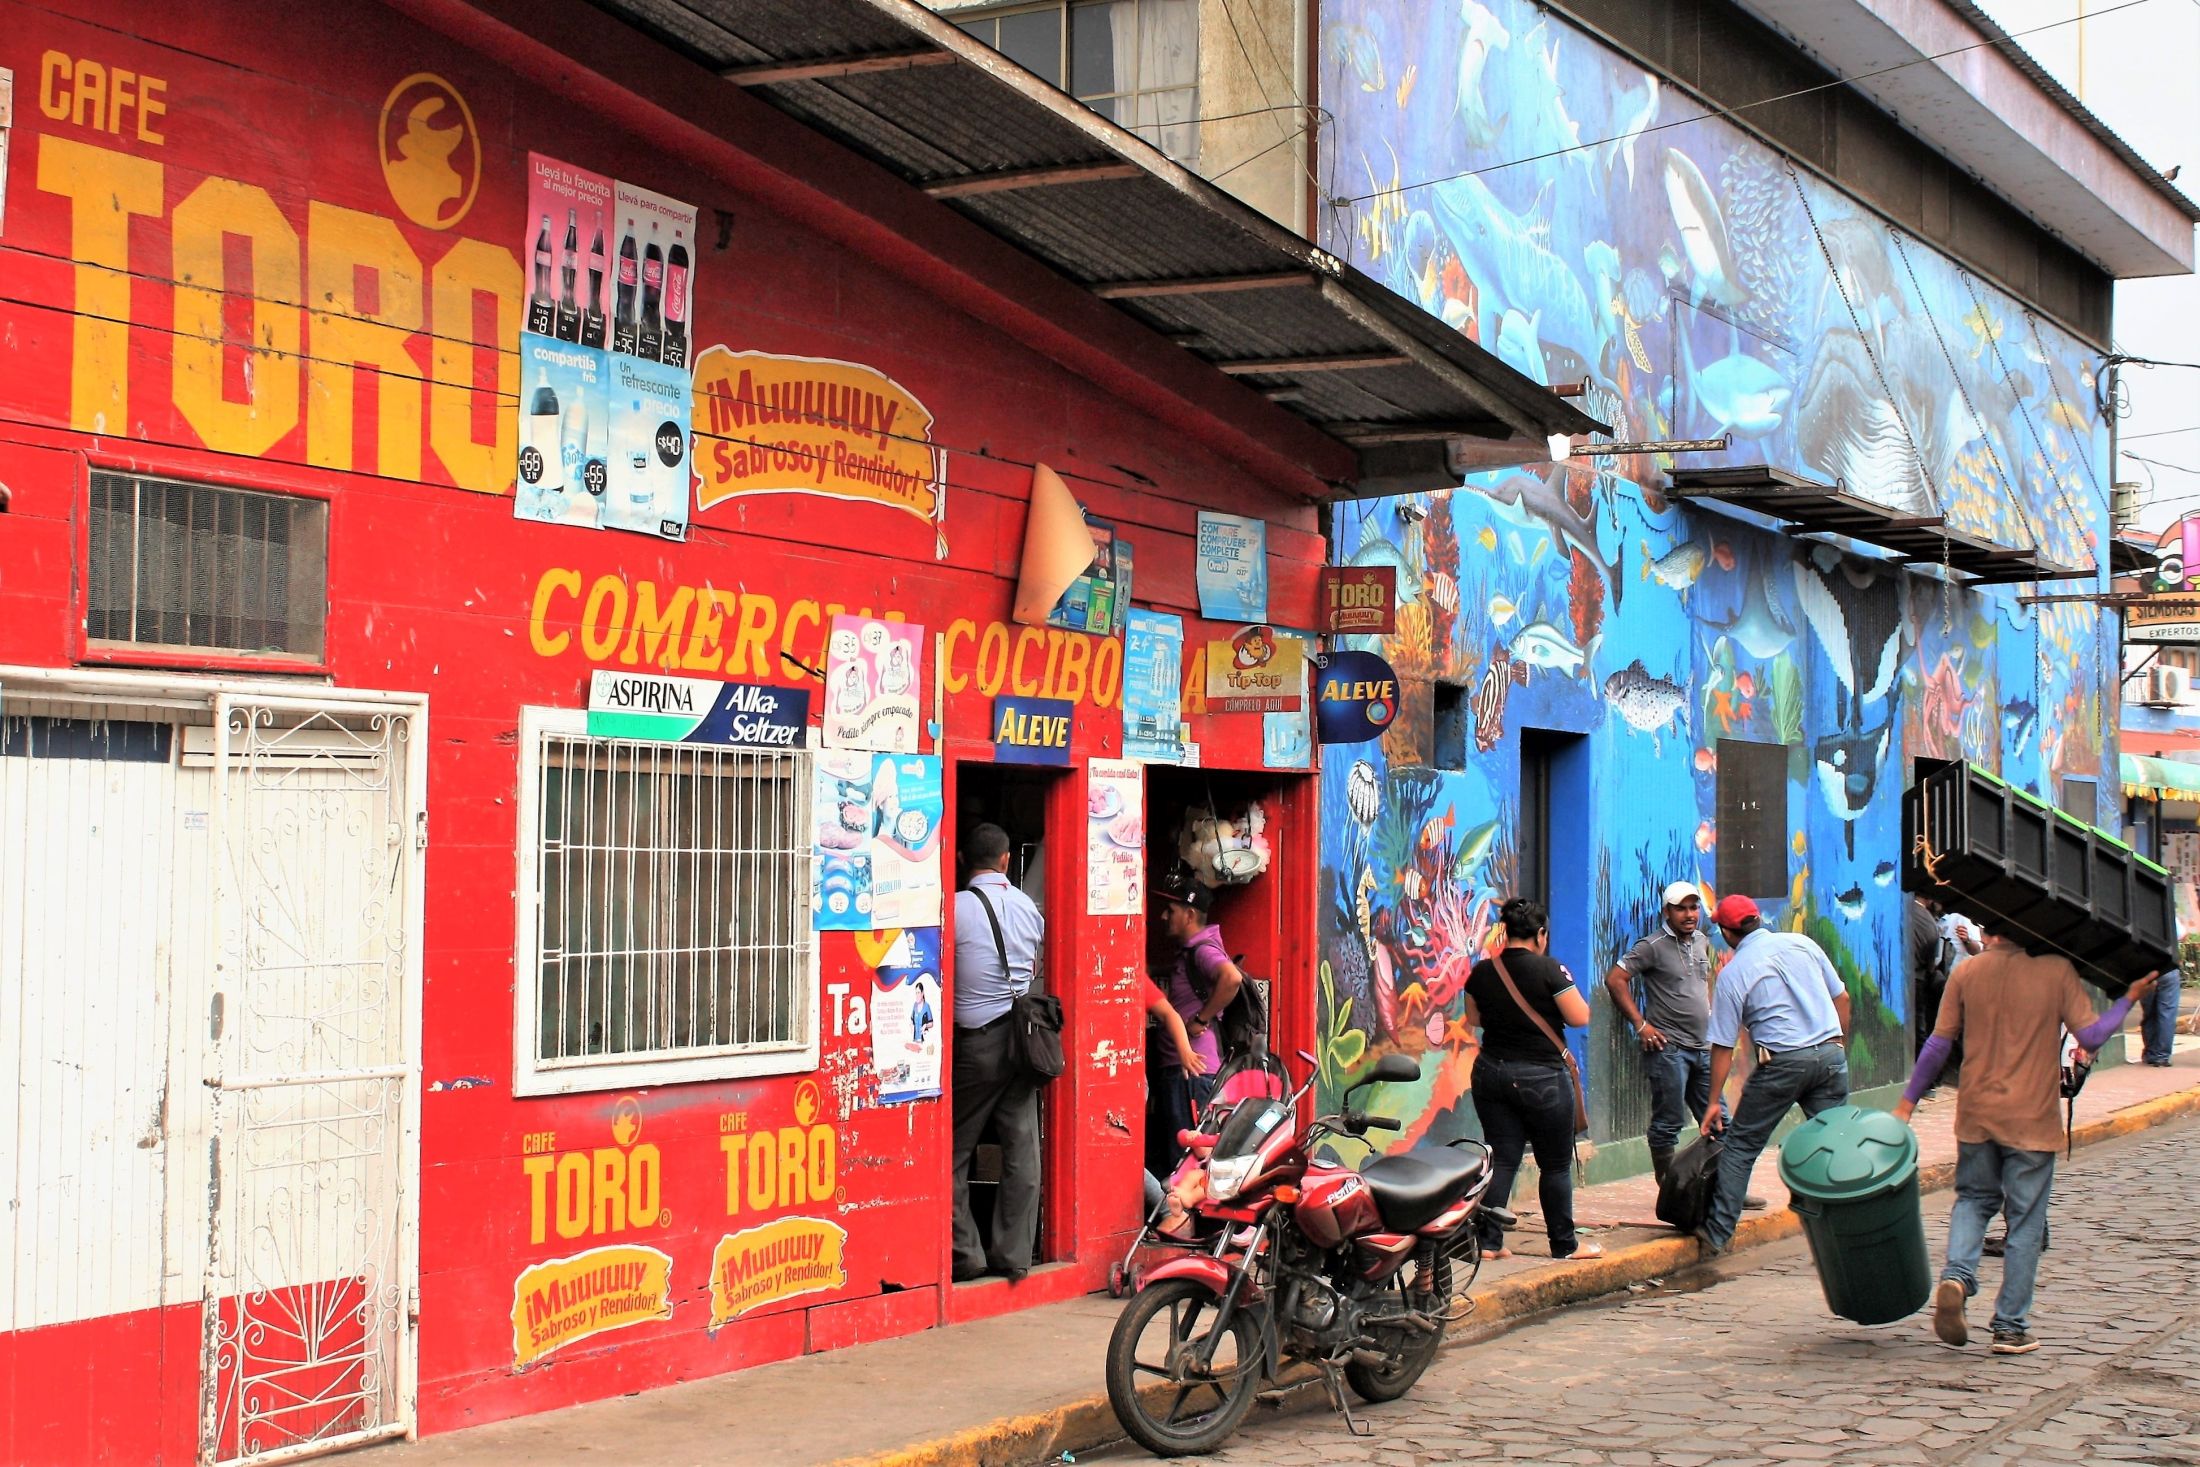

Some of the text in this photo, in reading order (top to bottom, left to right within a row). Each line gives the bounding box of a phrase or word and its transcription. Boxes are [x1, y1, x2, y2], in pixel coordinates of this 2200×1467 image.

[40, 49, 167, 146] CAFE
[535, 161, 611, 198] Llevá tu favorita
[543, 178, 603, 206] al mejor precio
[618, 190, 693, 225] Llevá para compartir
[37, 133, 525, 495] TORO
[533, 347, 596, 371] compartila
[620, 361, 631, 373] Un
[621, 374, 681, 400] refrescante
[713, 435, 814, 485] Sabroso
[833, 440, 920, 502] Rendidor!
[1200, 534, 1246, 548] COMPRUEBE
[1200, 544, 1240, 558] COMPLETE
[1328, 583, 1385, 608] TORO
[528, 567, 1206, 714] COMERC COCIBOA
[2149, 627, 2199, 638] EXPERTOS
[1227, 671, 1281, 690] Tip-Top
[1320, 679, 1394, 703] ALEVE
[607, 678, 693, 713] ASPIRINA
[725, 685, 779, 714] Alka-
[882, 705, 913, 719] empacado
[729, 714, 799, 745] Seltzer
[996, 706, 1070, 749] ALEVE
[720, 1111, 747, 1133] CAFE
[523, 1132, 556, 1154] CAFE
[720, 1123, 836, 1216] TORO
[523, 1143, 661, 1245] TORO
[725, 1261, 833, 1310] Sabroso y Rendidor!
[530, 1292, 657, 1349] Sabroso y Rendidor!
